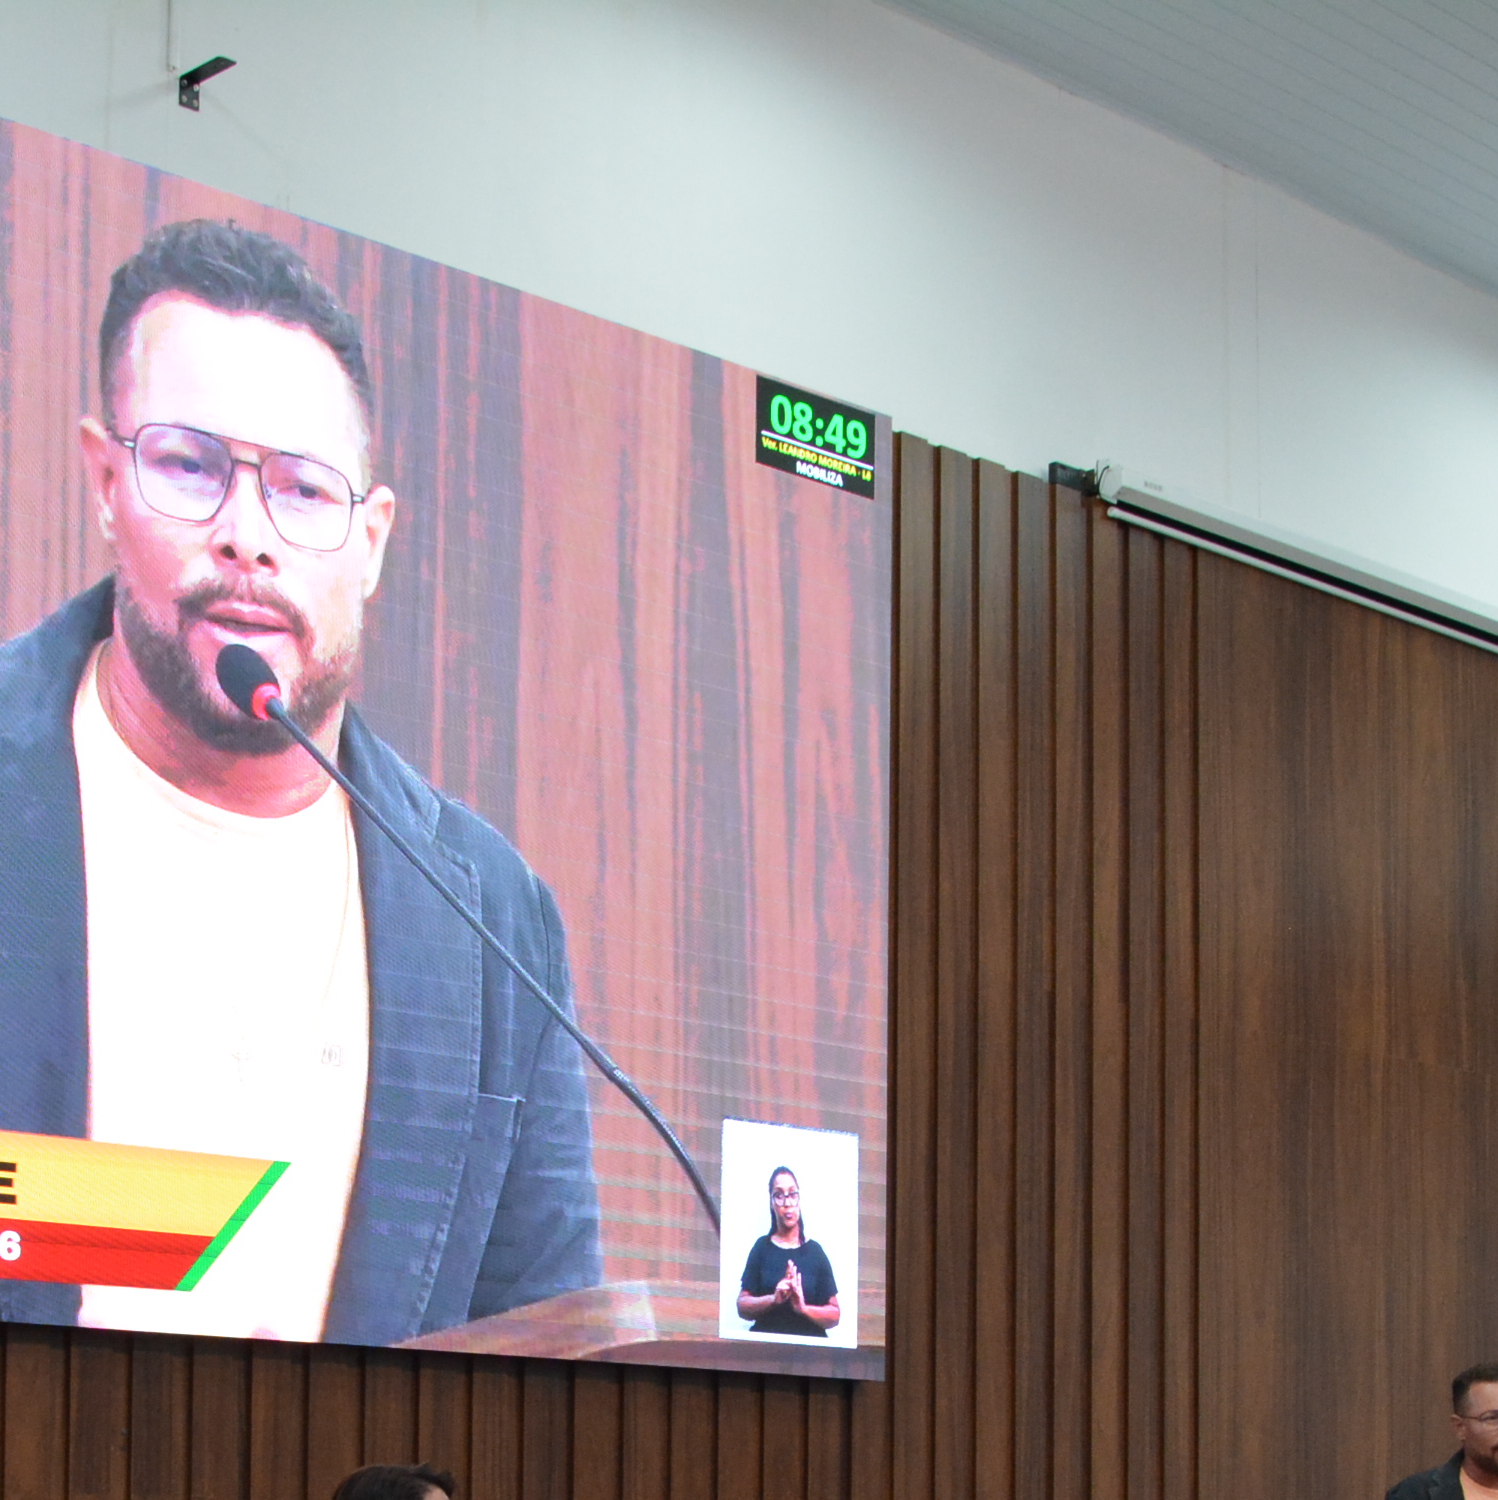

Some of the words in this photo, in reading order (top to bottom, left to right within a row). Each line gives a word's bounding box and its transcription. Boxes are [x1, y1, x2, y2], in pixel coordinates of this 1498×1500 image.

[770, 394, 867, 459] 08:49
[778, 442, 818, 465] LEANDRO
[818, 454, 857, 477] MOREIRA
[796, 461, 843, 487] MOBILIZA
